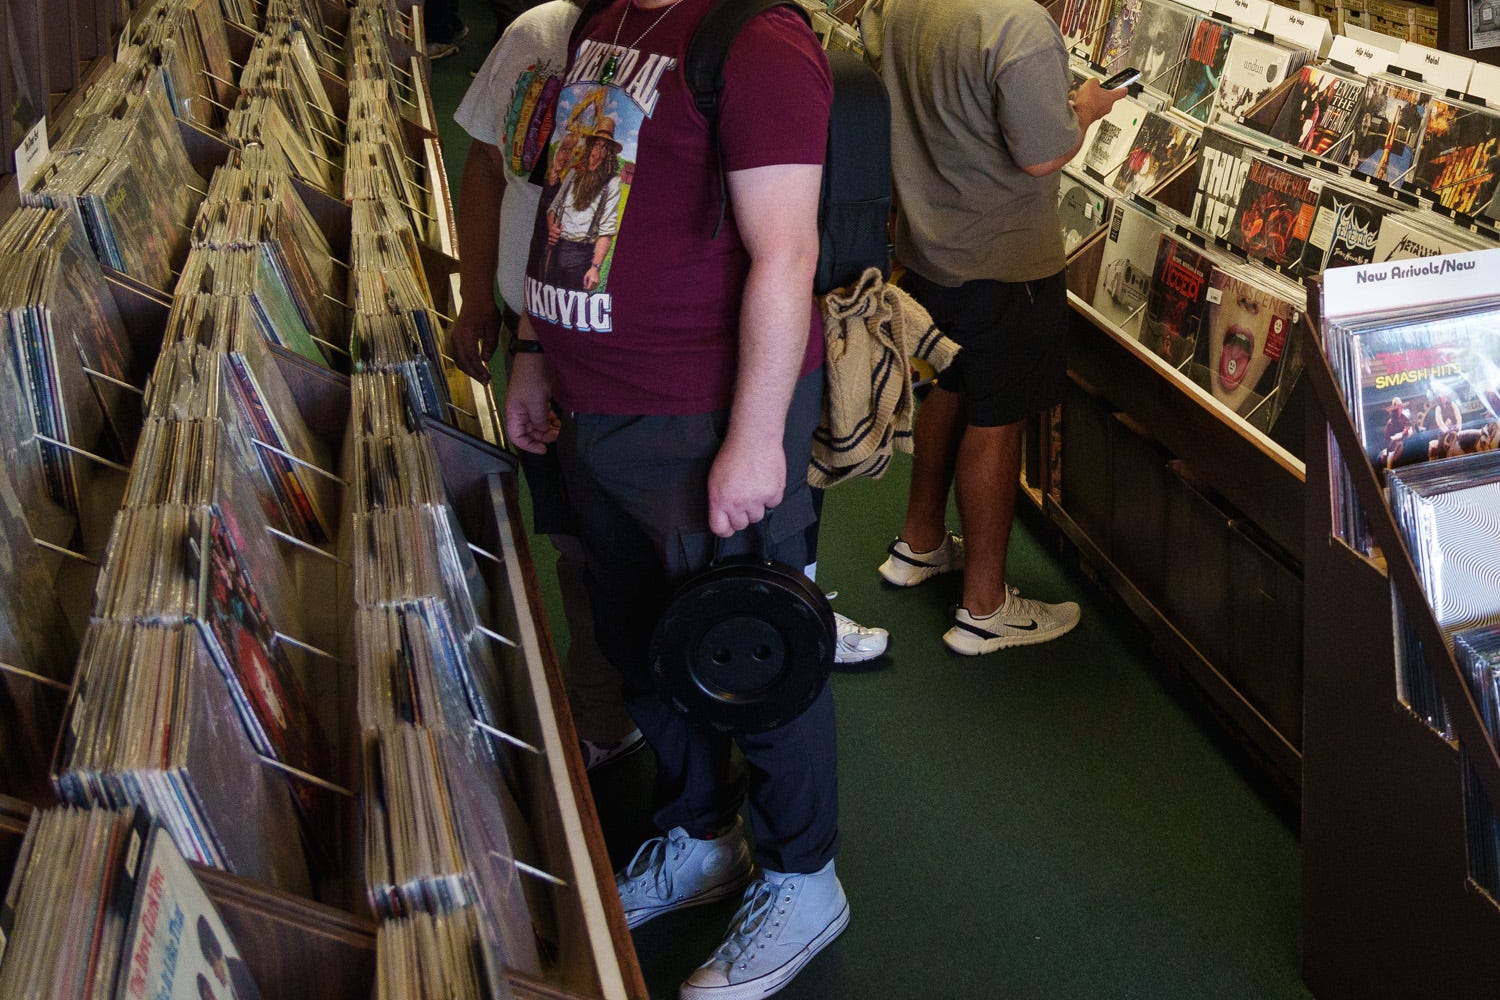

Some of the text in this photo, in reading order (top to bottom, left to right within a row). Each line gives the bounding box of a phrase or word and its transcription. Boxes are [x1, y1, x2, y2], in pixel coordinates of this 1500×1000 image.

[1425, 53, 1441, 66] Metal
[1336, 81, 1363, 102] ENTER
[1332, 96, 1356, 111] THE
[1356, 258, 1477, 284] New Arrivals/New
[1375, 362, 1461, 390] SMASH HITS
